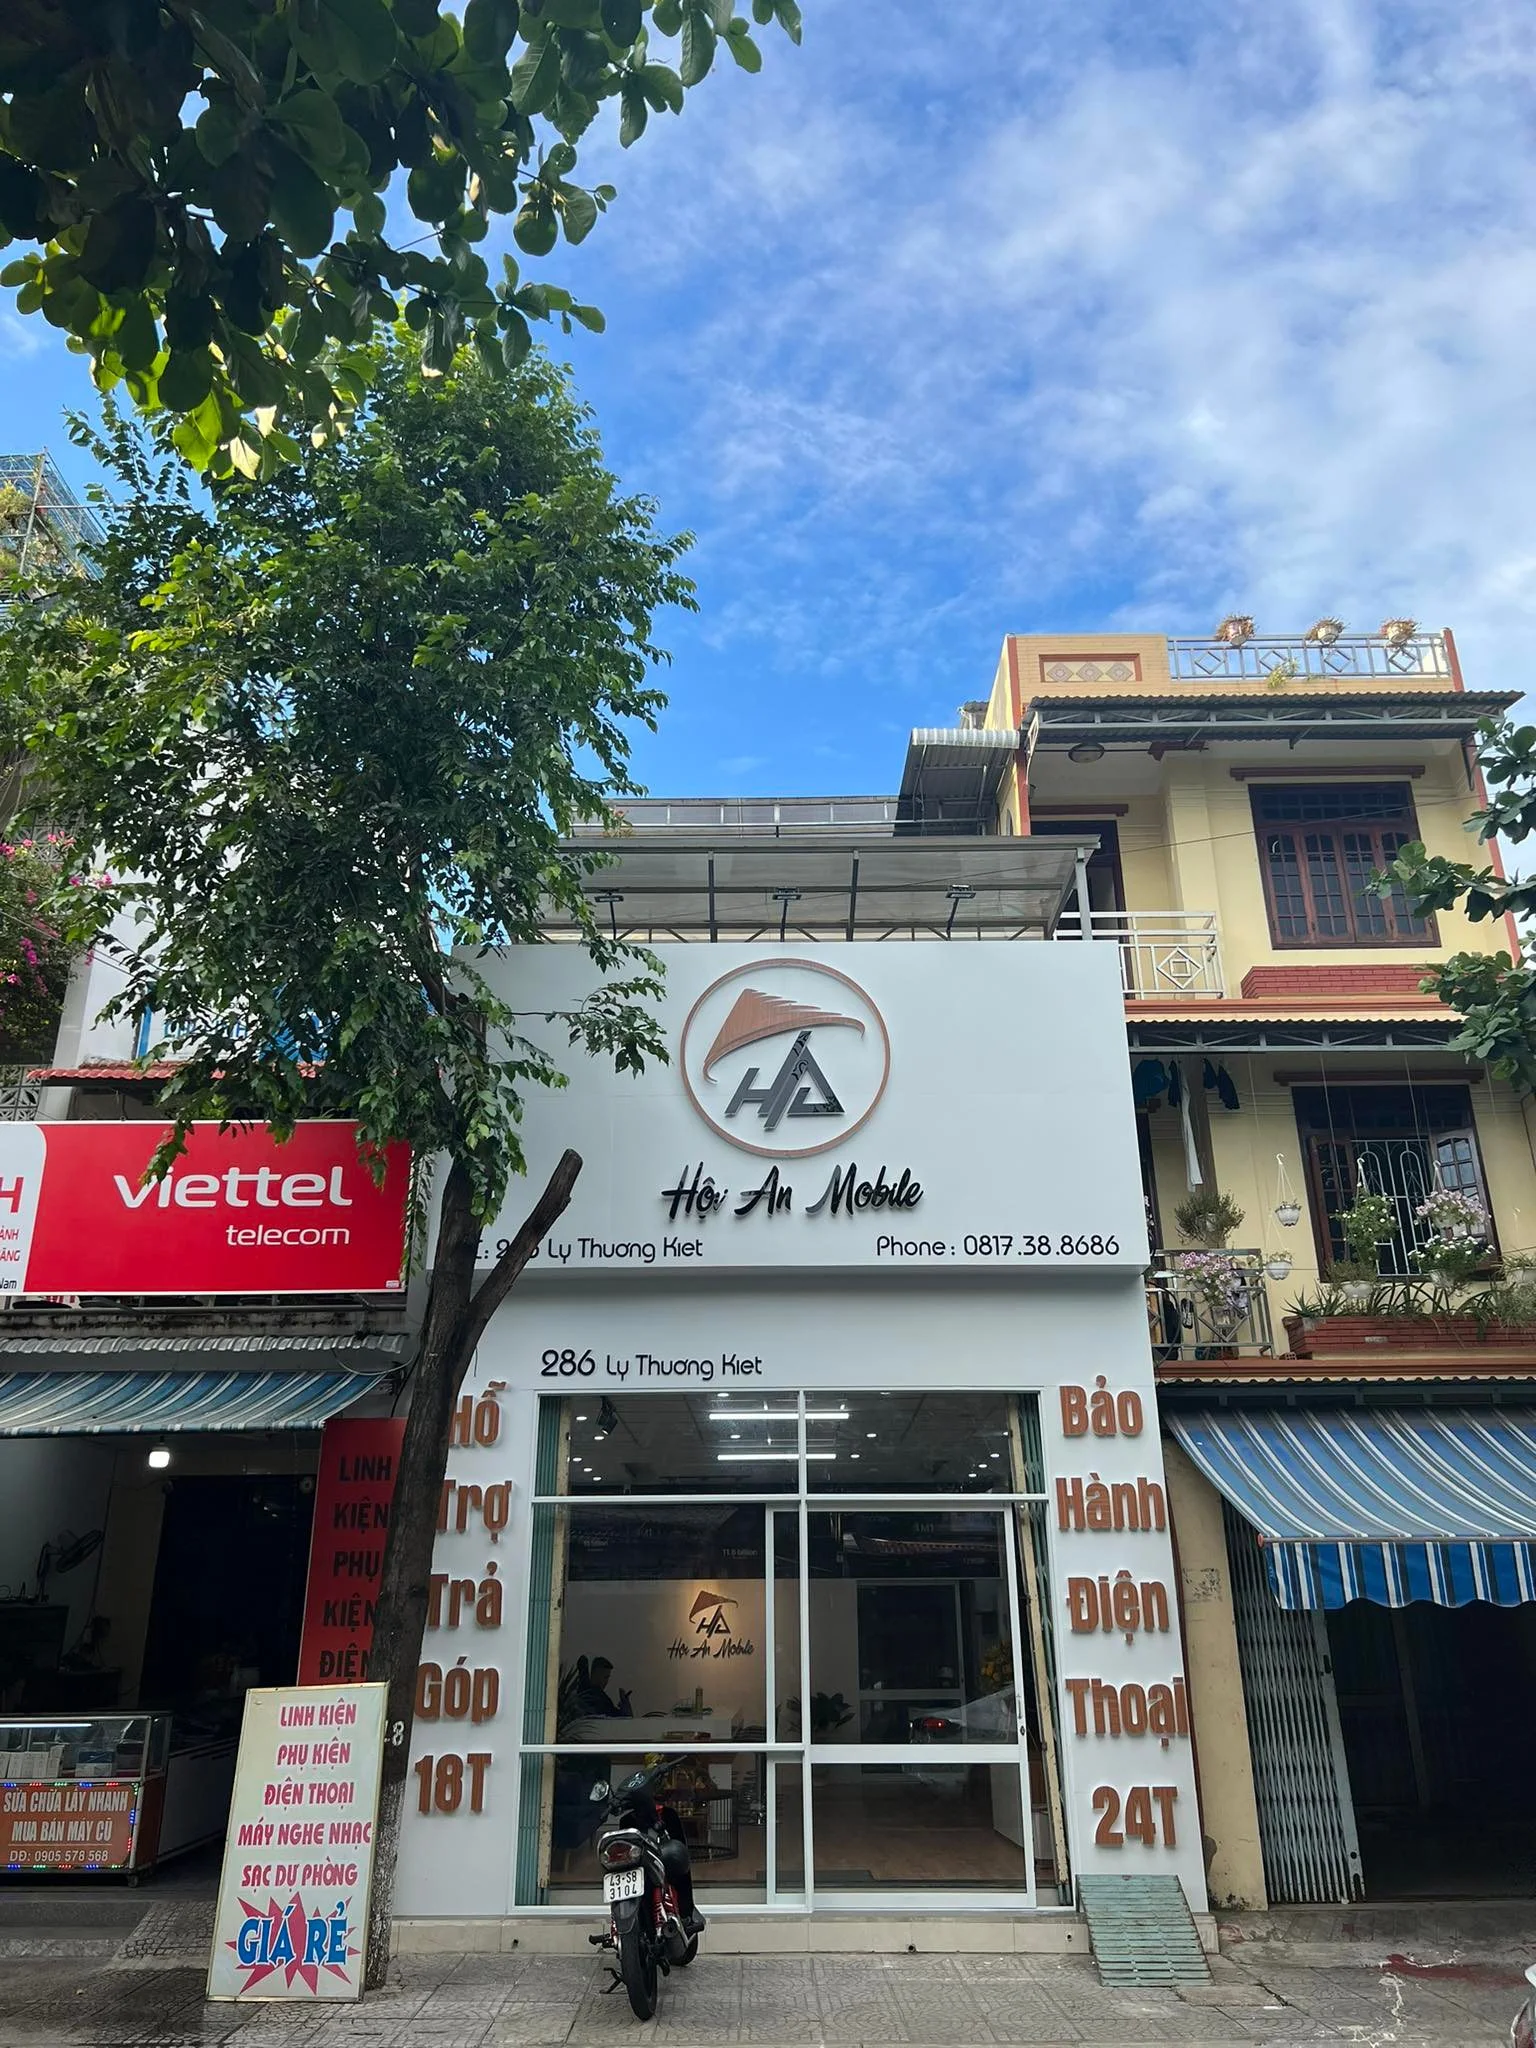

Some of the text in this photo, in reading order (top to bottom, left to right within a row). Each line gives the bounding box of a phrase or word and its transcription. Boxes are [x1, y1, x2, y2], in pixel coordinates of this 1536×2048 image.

[113, 1165, 353, 1209] viettel
[661, 1161, 925, 1220] Hội An Mobile
[225, 1223, 350, 1246] telecom
[541, 1348, 597, 1377] 286
[1059, 1374, 1144, 1438] Bảo
[338, 1455, 392, 1482] LINH
[1055, 1472, 1167, 1532] Hành
[333, 1551, 381, 1583] PHỤ
[426, 1561, 503, 1629] Trả
[1066, 1569, 1170, 1645] Điện
[415, 1656, 500, 1724] Góp
[280, 1698, 357, 1731] LINH KIỆN
[1065, 1676, 1189, 1748] Thoại
[277, 1736, 351, 1771] PHỤ KIỆN
[88, 1791, 129, 1812] NHANH
[264, 1777, 354, 1812] ĐIỆN THOẠI
[414, 1752, 493, 1815] 18T
[11, 1821, 38, 1842] MUA
[40, 1818, 65, 1841] BÁN
[67, 1818, 94, 1841] MÁY
[237, 1816, 371, 1851] MÁY NGHE NHẠC
[1091, 1785, 1178, 1847] 24T
[34, 1850, 62, 1862] 0905
[65, 1850, 85, 1862] 578
[88, 1850, 109, 1862] 568
[241, 1856, 358, 1894] SẠC DỰ PHÒNG
[609, 1883, 637, 1900] 3104
[237, 1900, 348, 1965] GIÁ RẺ
